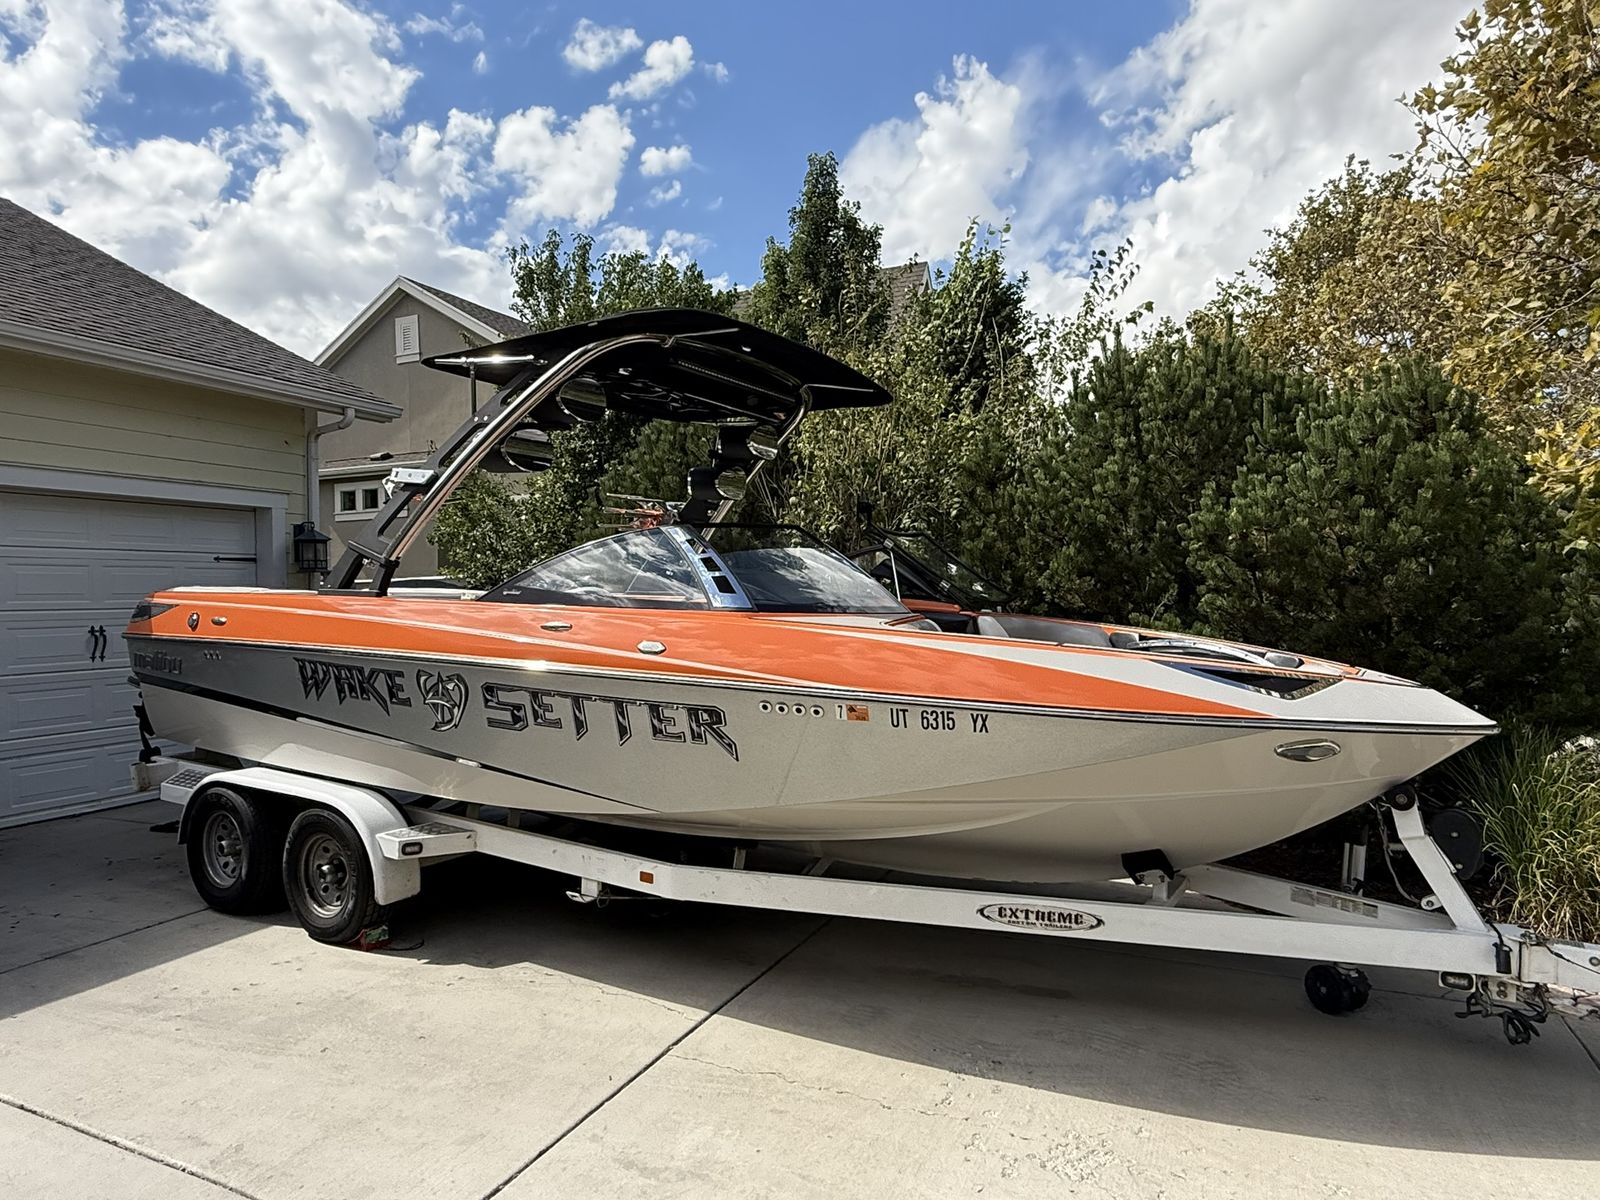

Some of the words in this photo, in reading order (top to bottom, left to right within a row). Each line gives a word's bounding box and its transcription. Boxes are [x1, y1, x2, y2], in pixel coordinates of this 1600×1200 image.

[293, 657, 412, 716] WAKE
[481, 681, 739, 762] SETTER
[890, 708, 909, 728] UT
[921, 710, 956, 731] 6315
[970, 713, 989, 734] YX
[997, 906, 1084, 926] EXTREME
